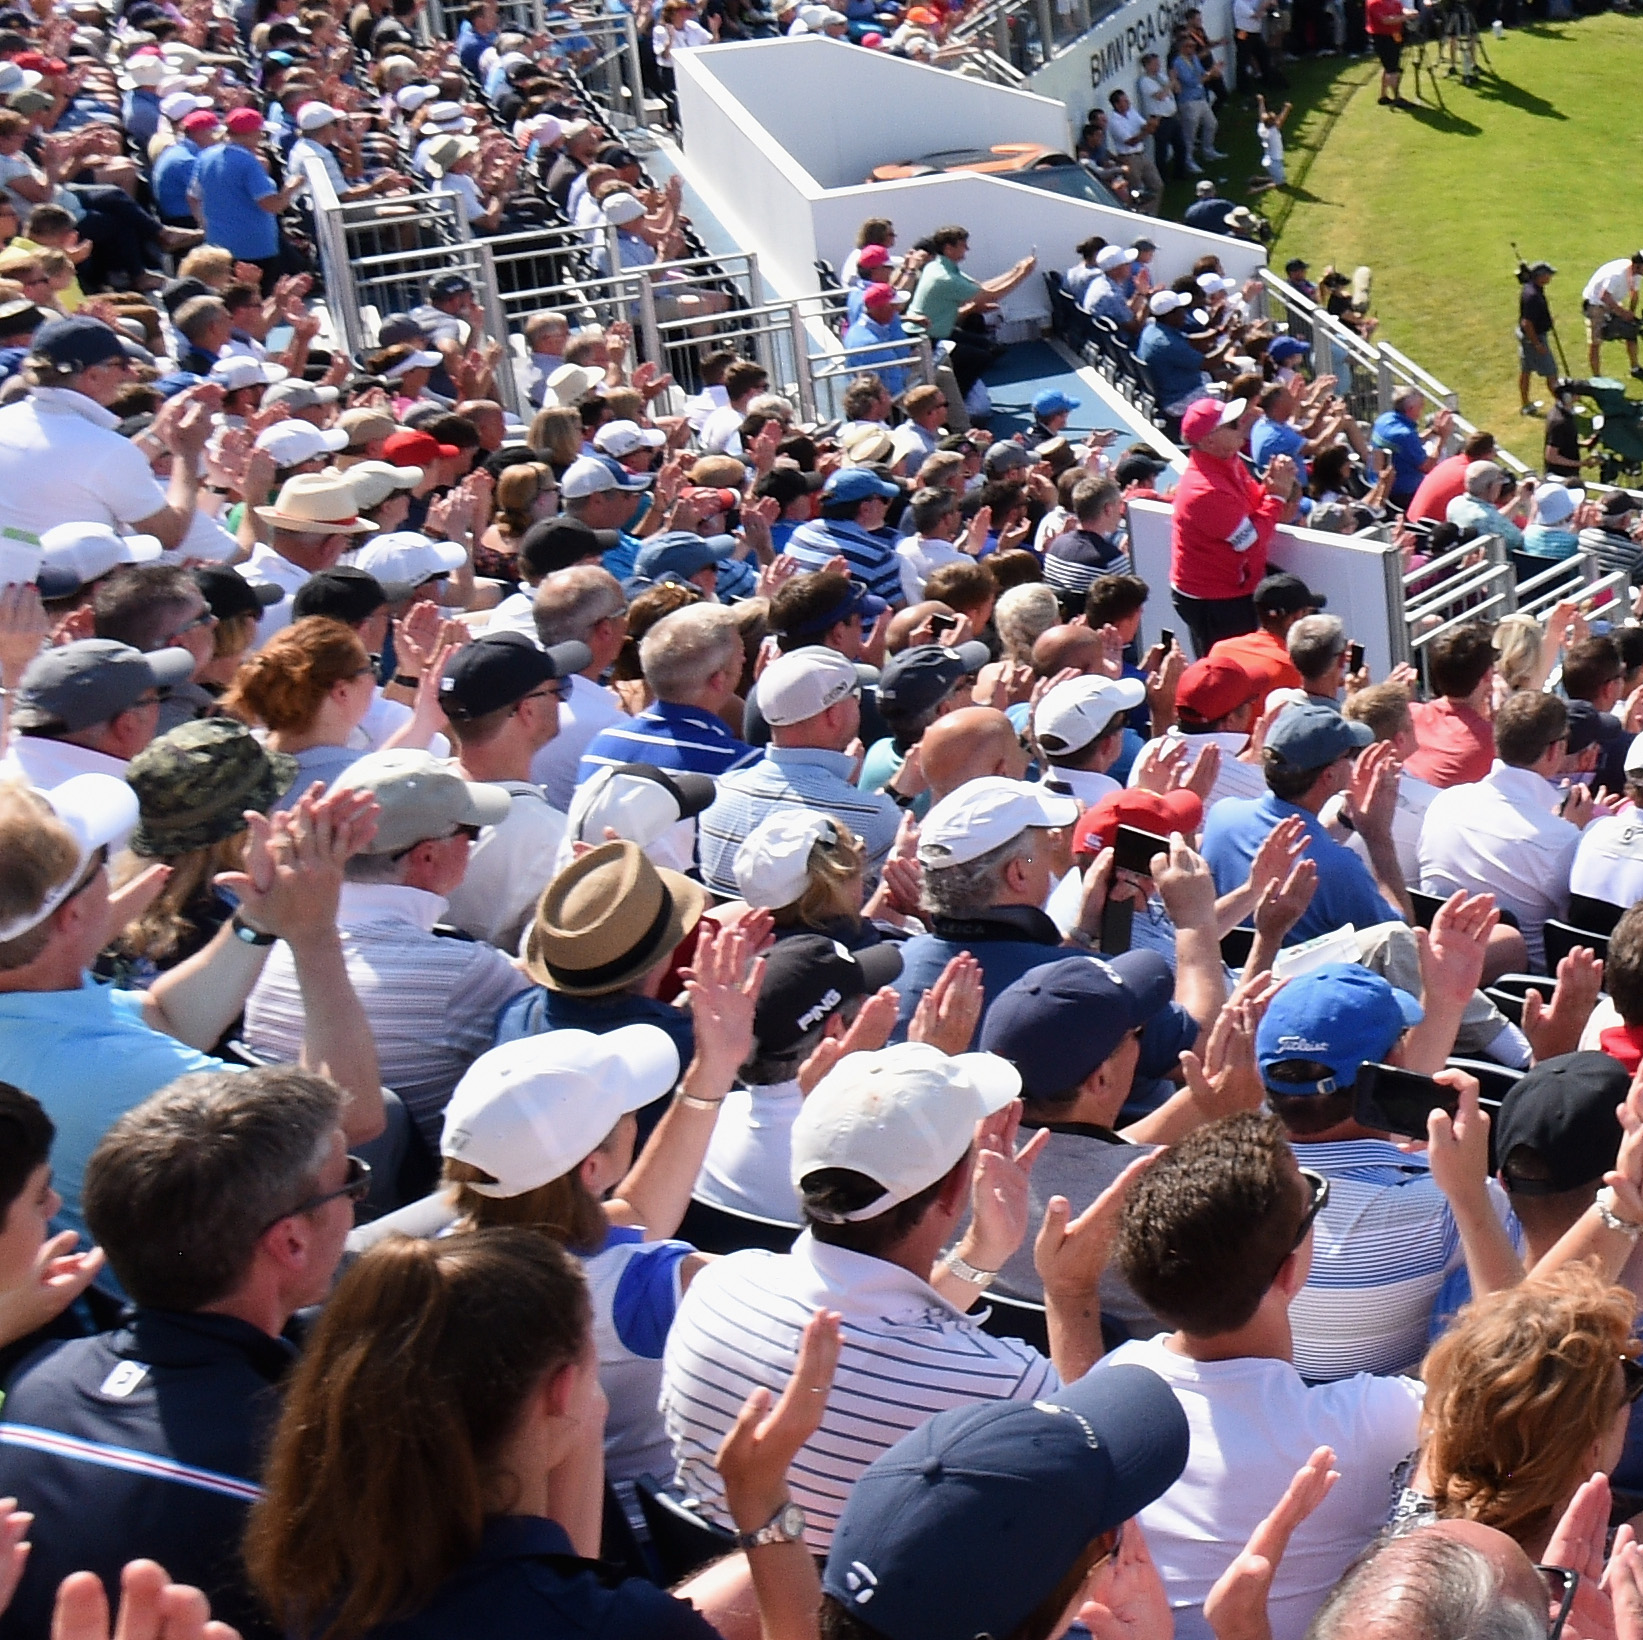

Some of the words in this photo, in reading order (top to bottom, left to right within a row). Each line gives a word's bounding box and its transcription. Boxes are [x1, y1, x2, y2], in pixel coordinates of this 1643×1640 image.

[1090, 34, 1126, 88] BMW
[1127, 14, 1157, 63] PGA
[797, 988, 841, 1031] PING
[1275, 1035, 1330, 1054] Titleist
